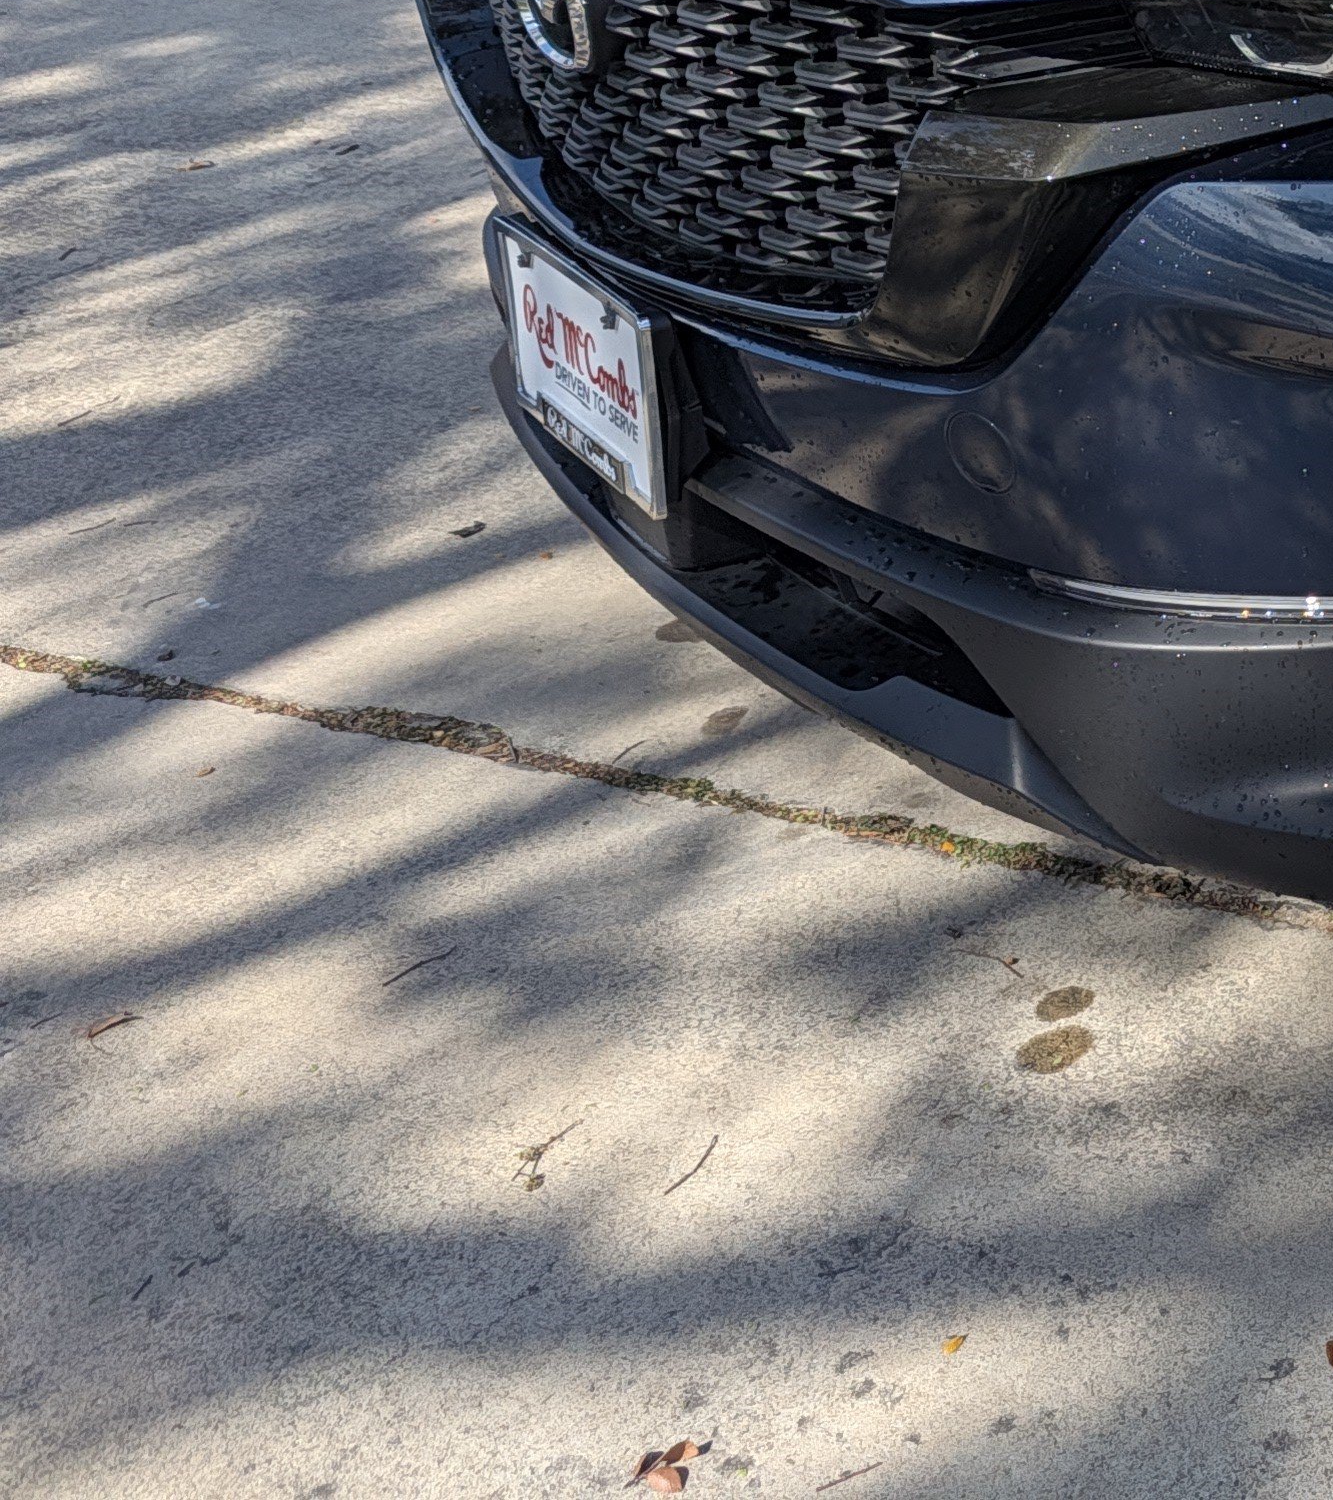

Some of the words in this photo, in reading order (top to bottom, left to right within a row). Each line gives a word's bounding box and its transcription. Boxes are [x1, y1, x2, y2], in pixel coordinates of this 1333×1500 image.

[523, 283, 557, 369] Red
[556, 312, 638, 420] McCombs
[546, 406, 568, 441] Red
[555, 360, 592, 404] DRIVEN
[592, 390, 607, 417] TO
[608, 403, 639, 444] SERVE
